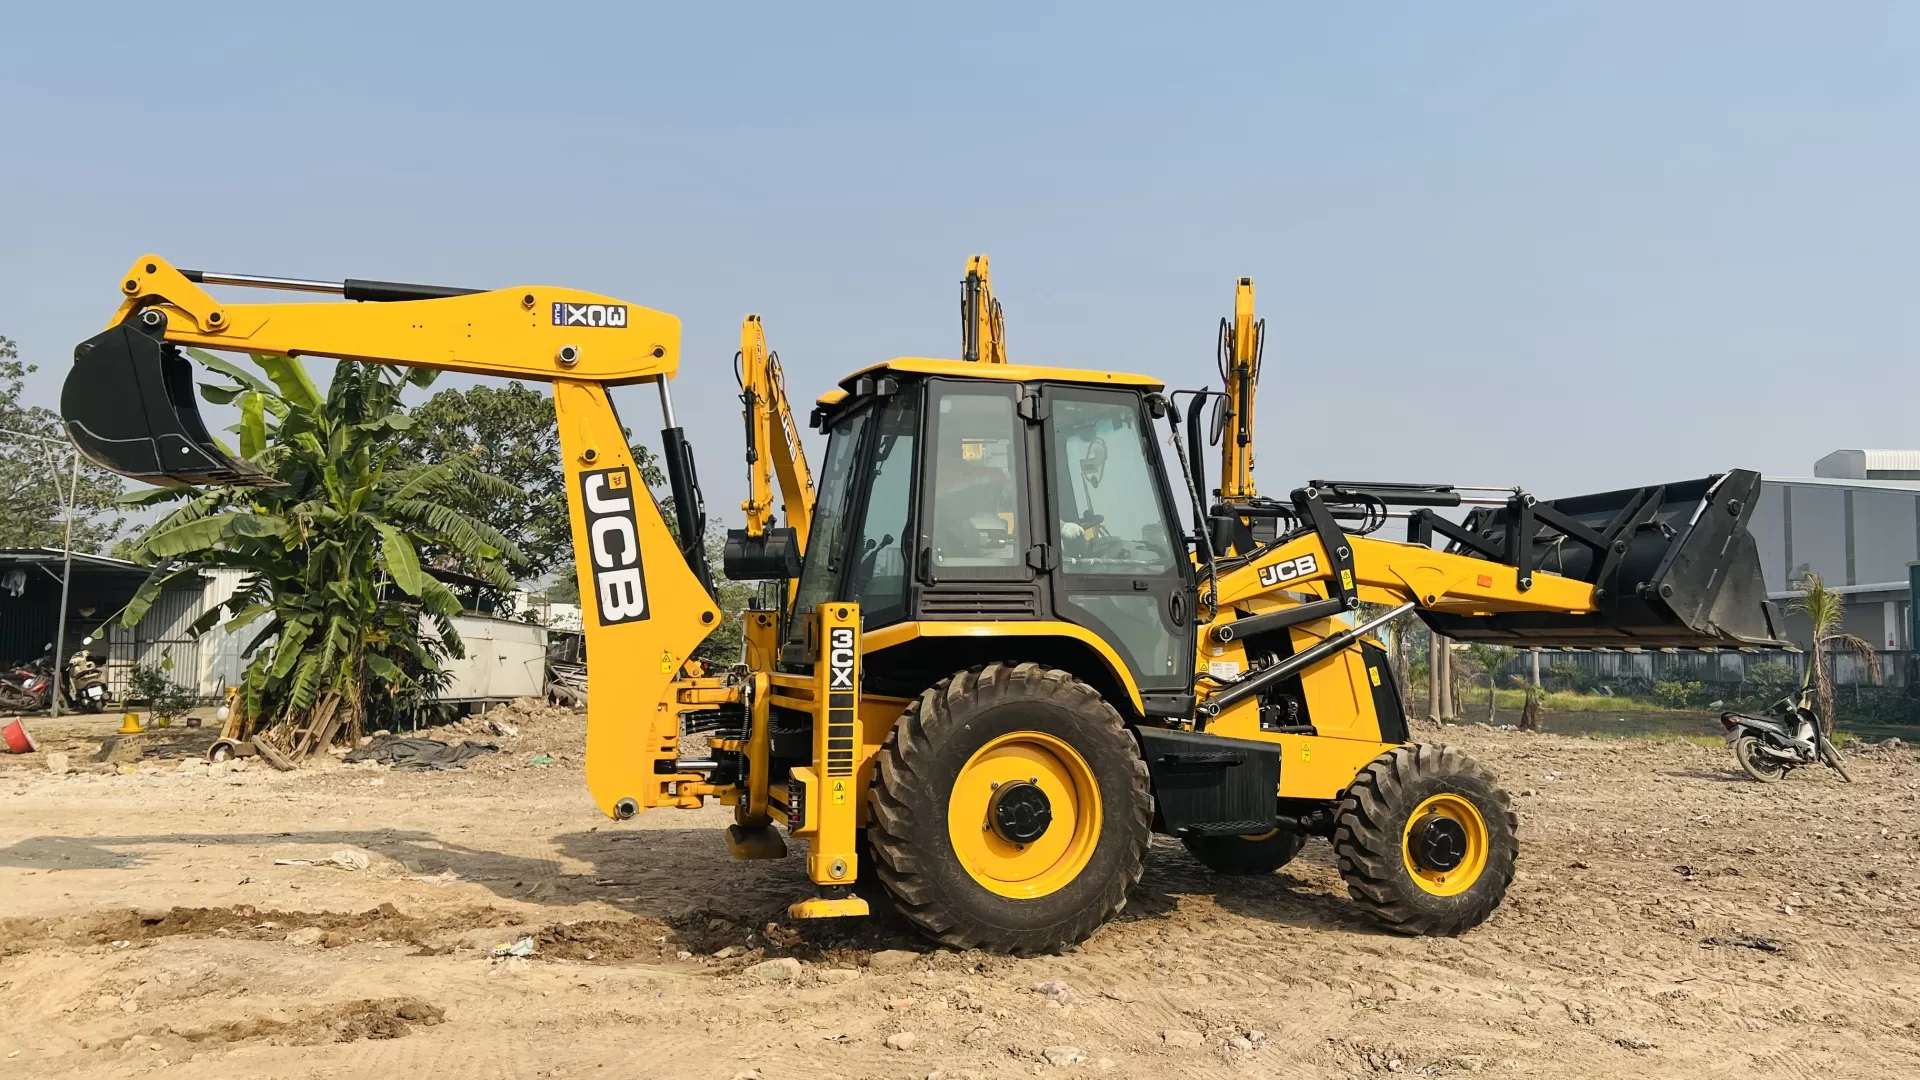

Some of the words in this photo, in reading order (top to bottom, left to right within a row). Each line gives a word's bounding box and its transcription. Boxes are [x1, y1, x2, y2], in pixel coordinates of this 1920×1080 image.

[567, 303, 626, 326] 3CX
[780, 414, 797, 463] JCB
[585, 473, 644, 622] JCB
[1261, 555, 1317, 586] JCB
[831, 629, 853, 687] 3CX
